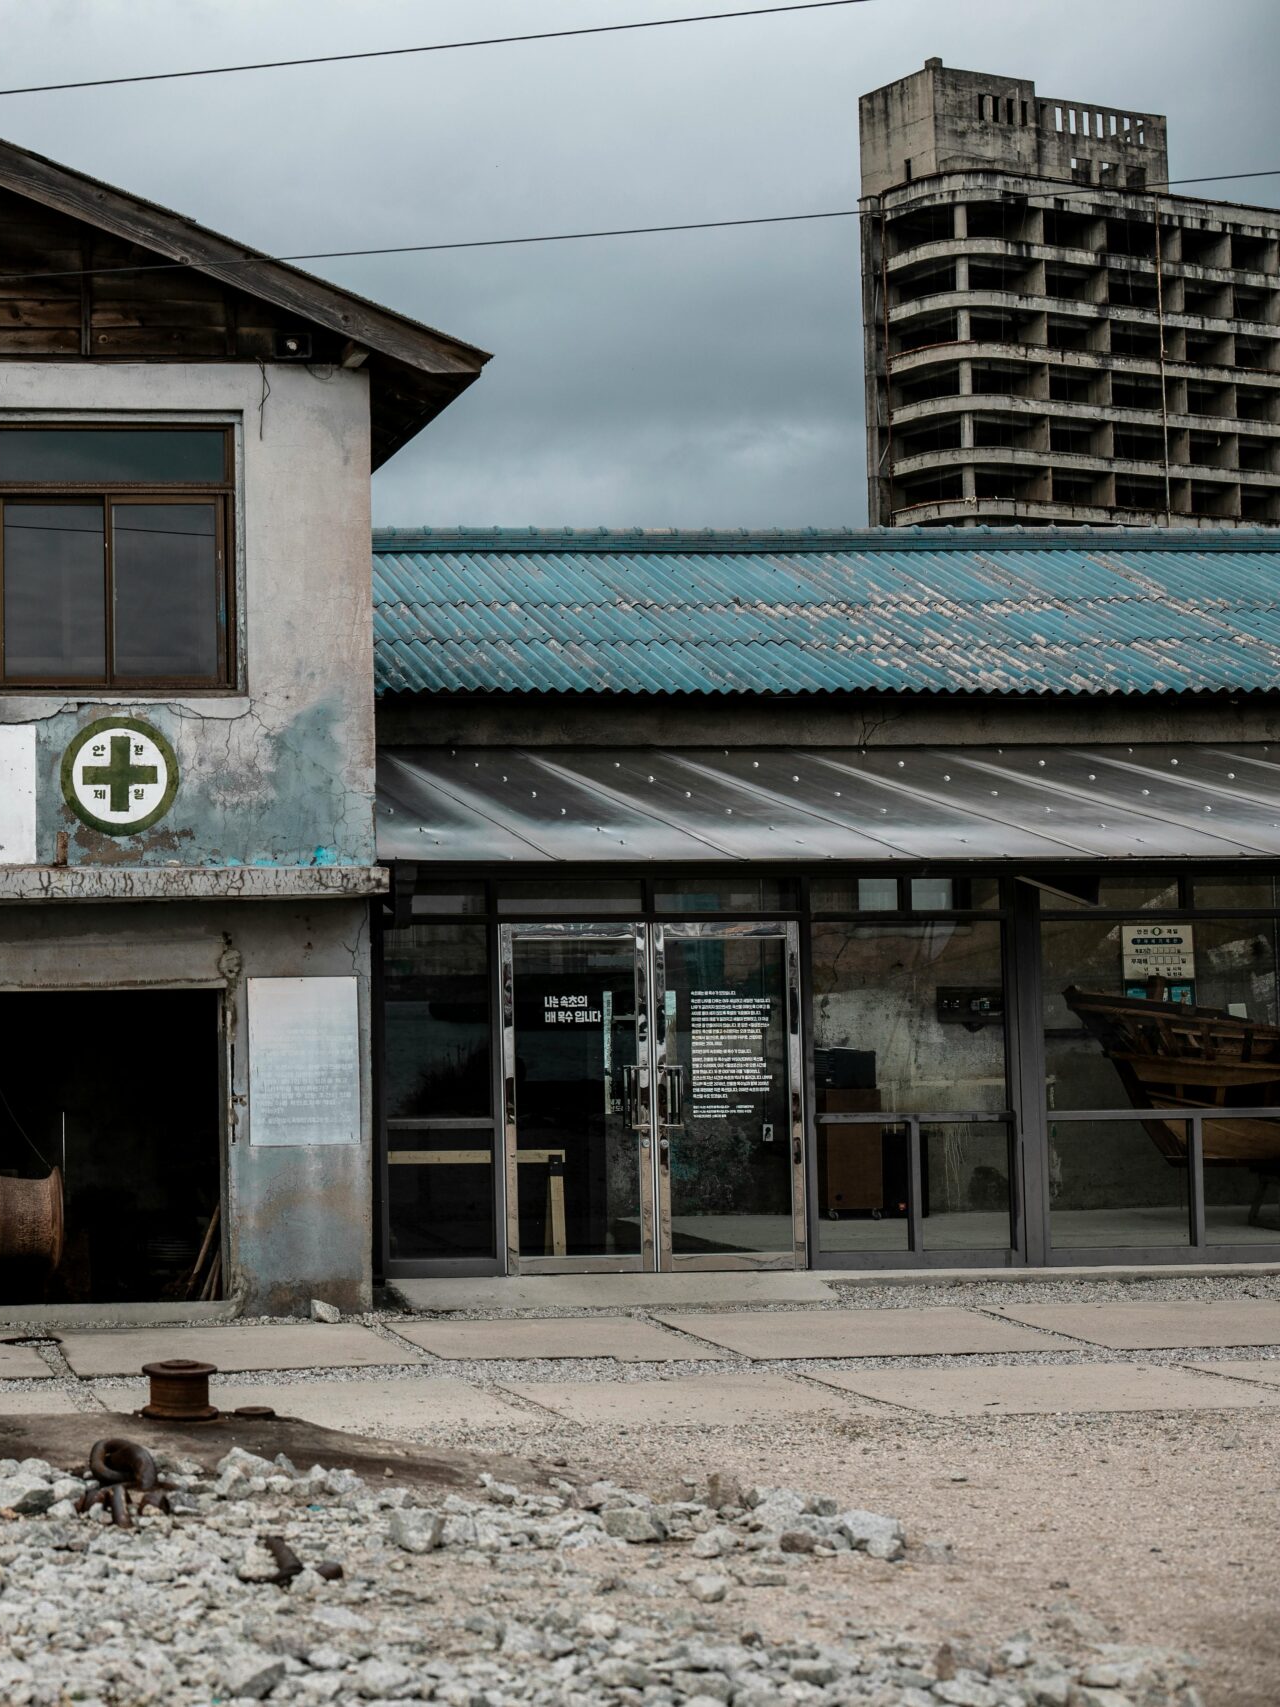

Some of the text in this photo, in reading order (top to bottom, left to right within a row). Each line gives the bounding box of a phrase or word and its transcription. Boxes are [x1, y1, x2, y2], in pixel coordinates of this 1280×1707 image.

[544, 995, 588, 1008] 나는 속초의
[545, 1010, 602, 1023] 배 목수 입니다
